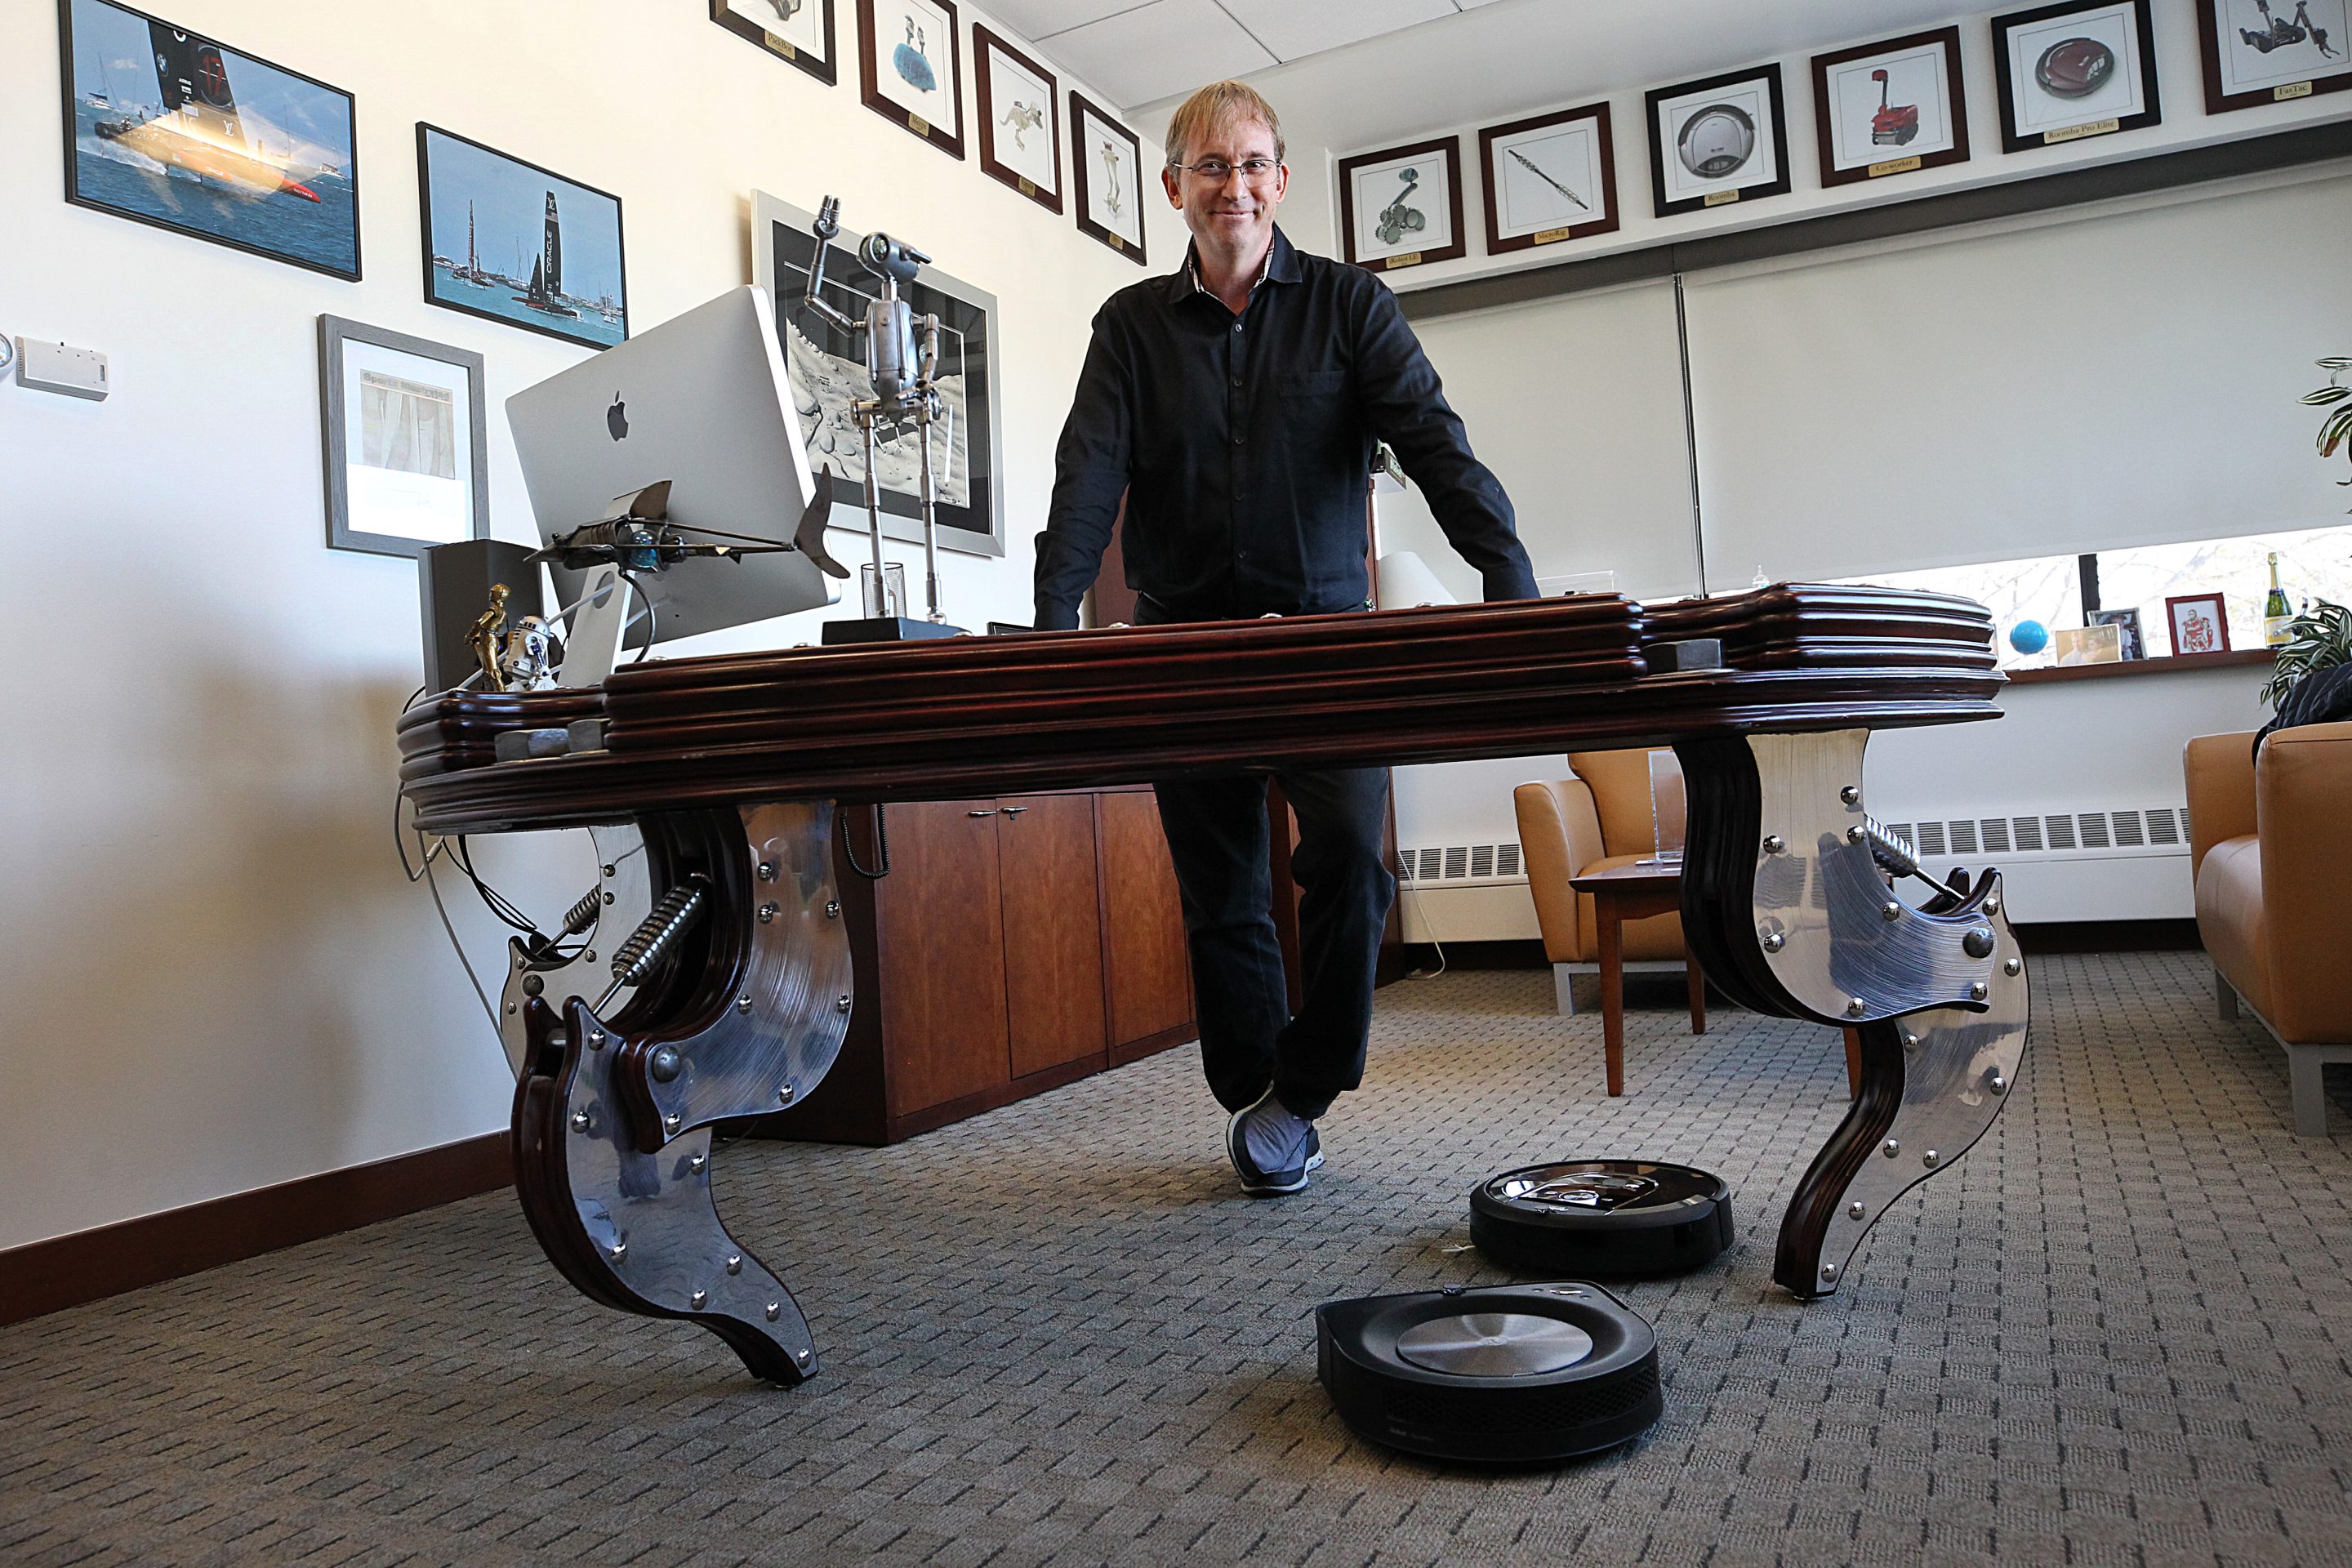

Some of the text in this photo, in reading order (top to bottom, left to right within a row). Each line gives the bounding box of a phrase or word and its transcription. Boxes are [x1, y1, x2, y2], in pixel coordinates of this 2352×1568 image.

[768, 33, 792, 52] PackBot
[2279, 84, 2307, 95] FasTac
[2048, 128, 2079, 139] Roomba
[2097, 121, 2115, 129] Elite
[363, 372, 450, 401] Sports Illustrated
